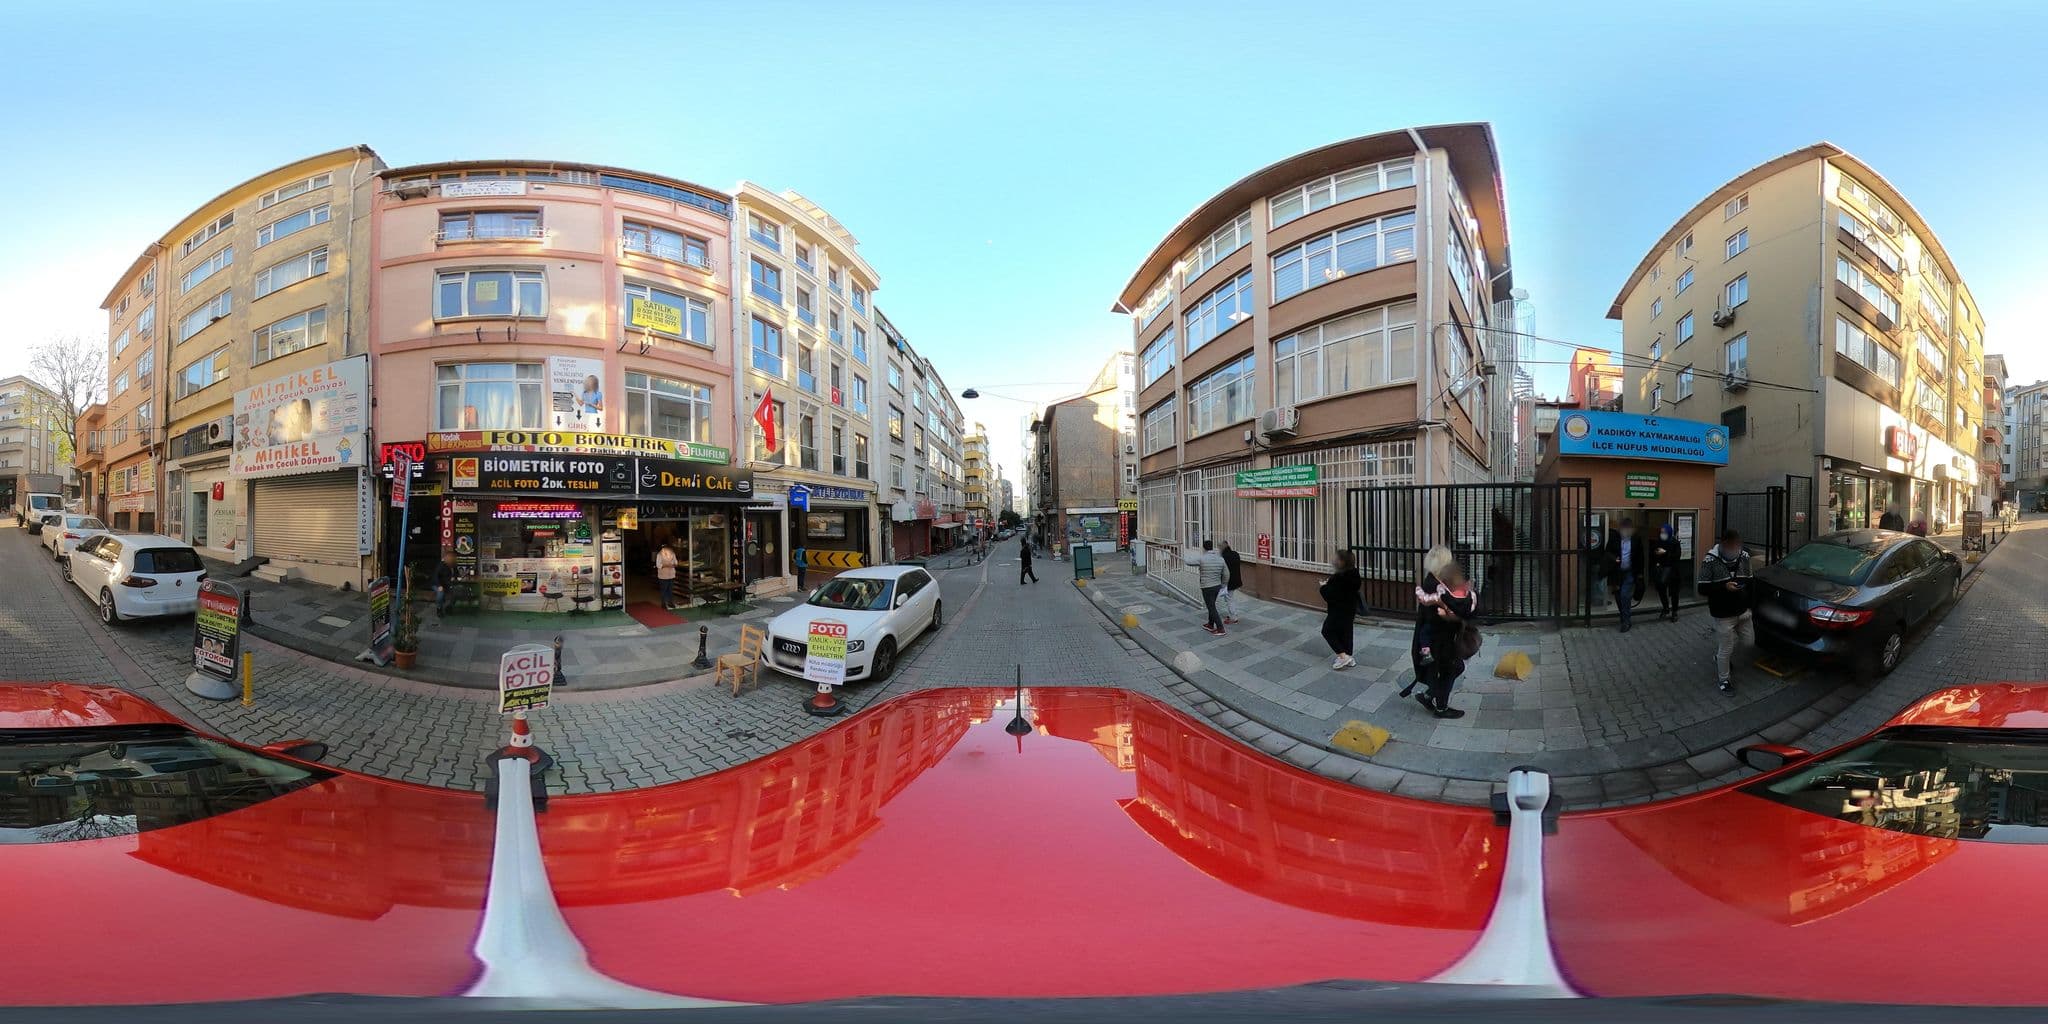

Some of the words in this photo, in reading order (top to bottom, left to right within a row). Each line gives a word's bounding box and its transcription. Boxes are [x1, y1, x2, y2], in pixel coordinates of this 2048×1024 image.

[307, 381, 347, 394] Dünyası
[1643, 418, 1660, 427] T.C.
[441, 433, 460, 442] Kodak
[491, 431, 562, 445] FOTO
[1597, 428, 1637, 438] KADIKÖY
[1639, 431, 1701, 444] KAYMAKAMLIĞI
[690, 448, 726, 460] FUJIFILM
[1592, 440, 1614, 451] İLÇE
[1616, 442, 1649, 452] NÜFUS
[1651, 444, 1705, 457] MÜDÜRLÜĞÜ
[244, 464, 265, 473] Bebek
[275, 458, 299, 471] Çocuk
[301, 456, 336, 467] Dünyası
[570, 461, 605, 475] FOTO
[514, 479, 540, 488] FOTO
[568, 476, 599, 490] TESLİM
[810, 623, 845, 634] FOTO
[507, 653, 550, 672] ACİL
[506, 670, 550, 689] FOTO
